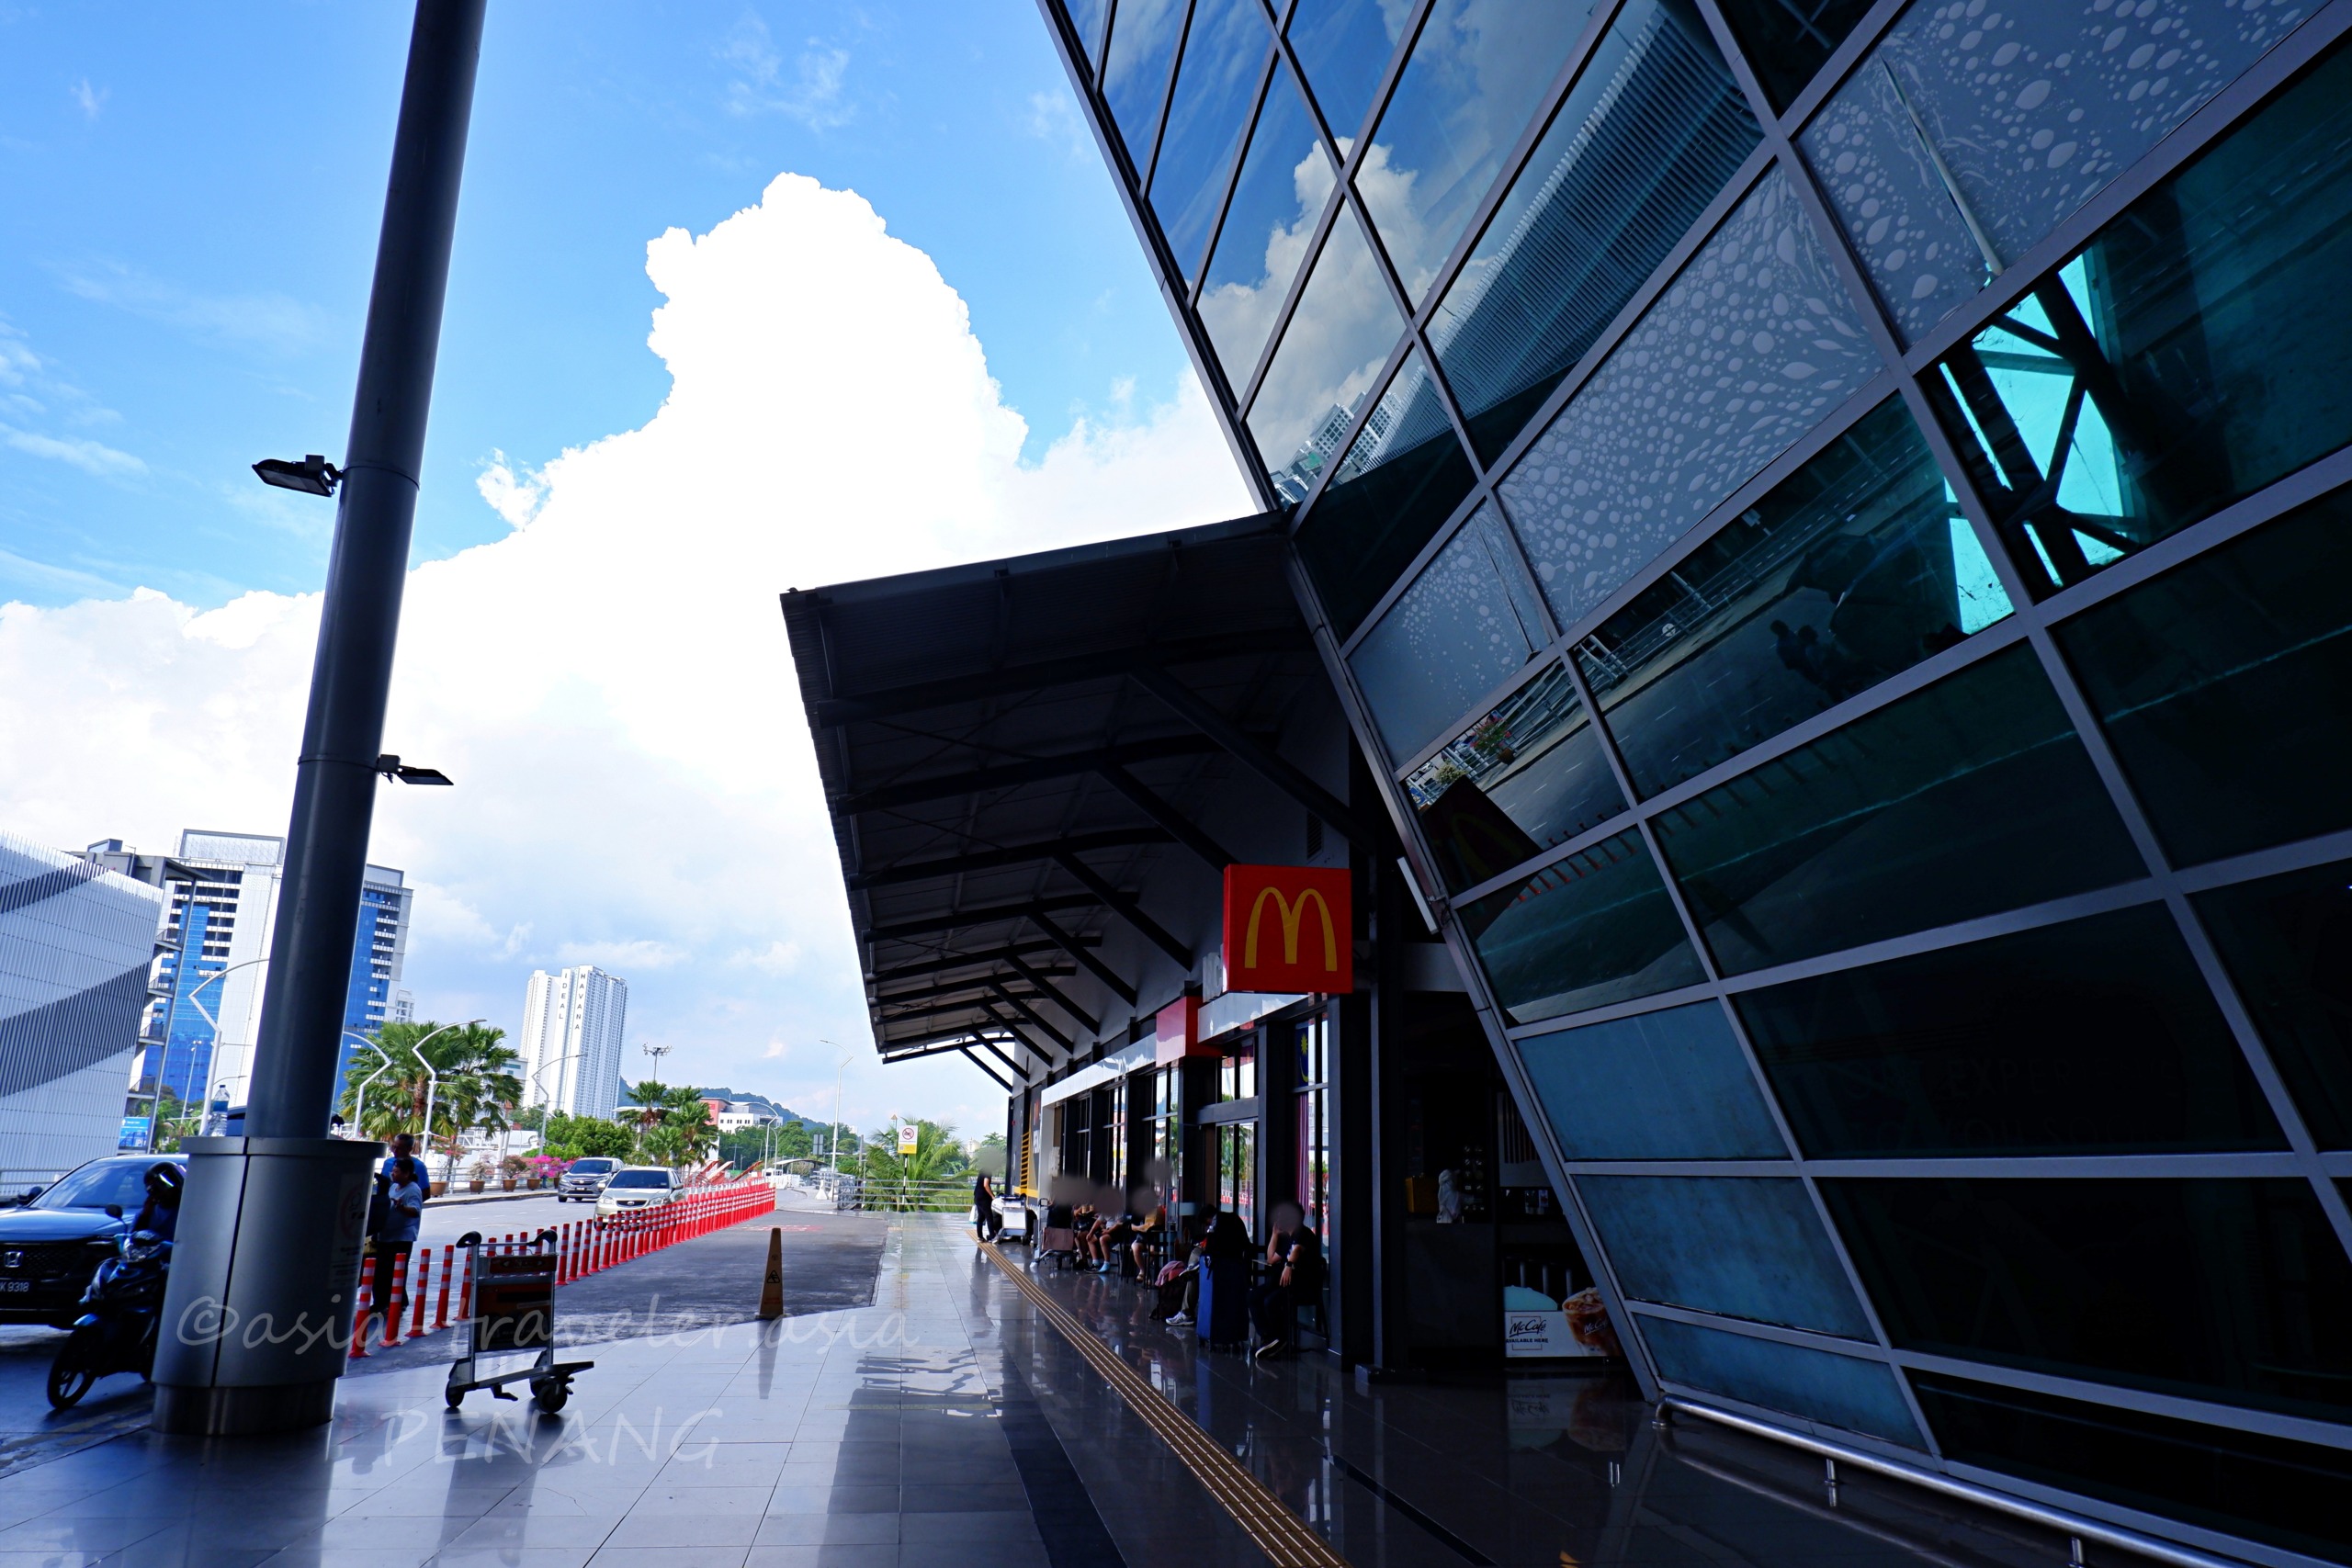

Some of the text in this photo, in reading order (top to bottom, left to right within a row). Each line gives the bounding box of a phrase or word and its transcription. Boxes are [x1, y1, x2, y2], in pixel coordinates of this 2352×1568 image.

[559, 974, 568, 1019] IDEAL
[574, 974, 586, 1029] HAVANA
[7, 1281, 29, 1292] 9318
[1510, 1319, 1546, 1337] McCafé
